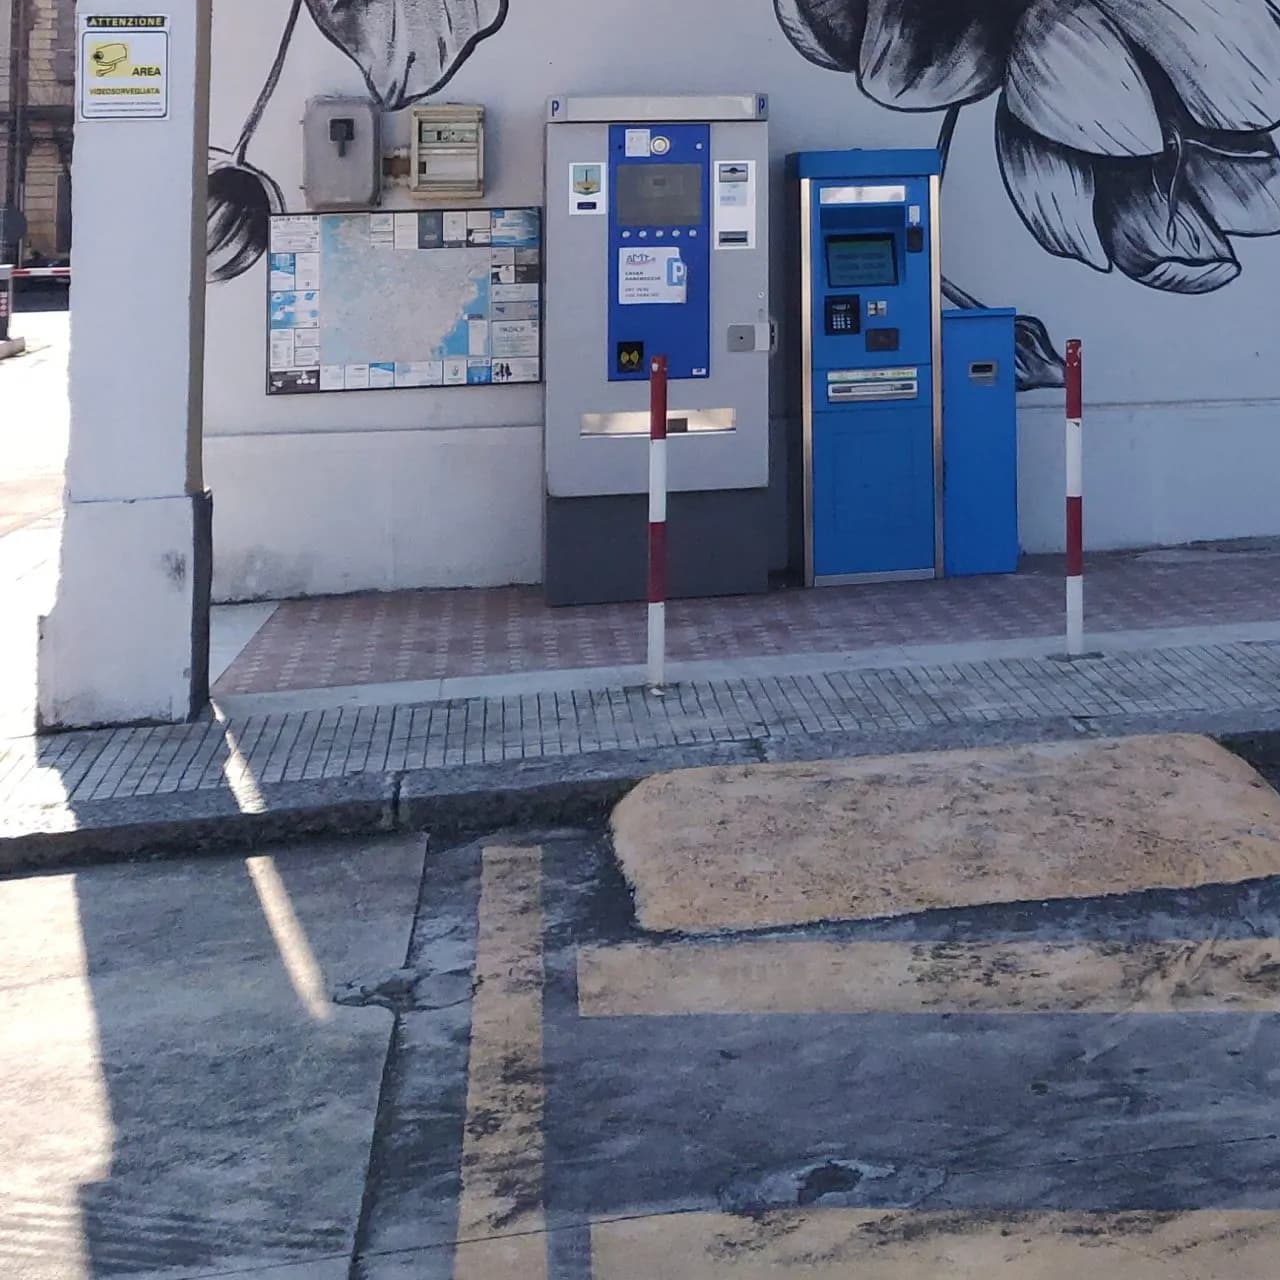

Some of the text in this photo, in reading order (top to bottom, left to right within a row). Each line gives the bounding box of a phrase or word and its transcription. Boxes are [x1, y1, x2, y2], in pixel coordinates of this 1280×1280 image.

[89, 17, 164, 26] ATTENZIONE
[131, 66, 162, 77] AREA
[551, 100, 560, 117] P
[758, 98, 766, 113] P
[672, 261, 684, 283] P
